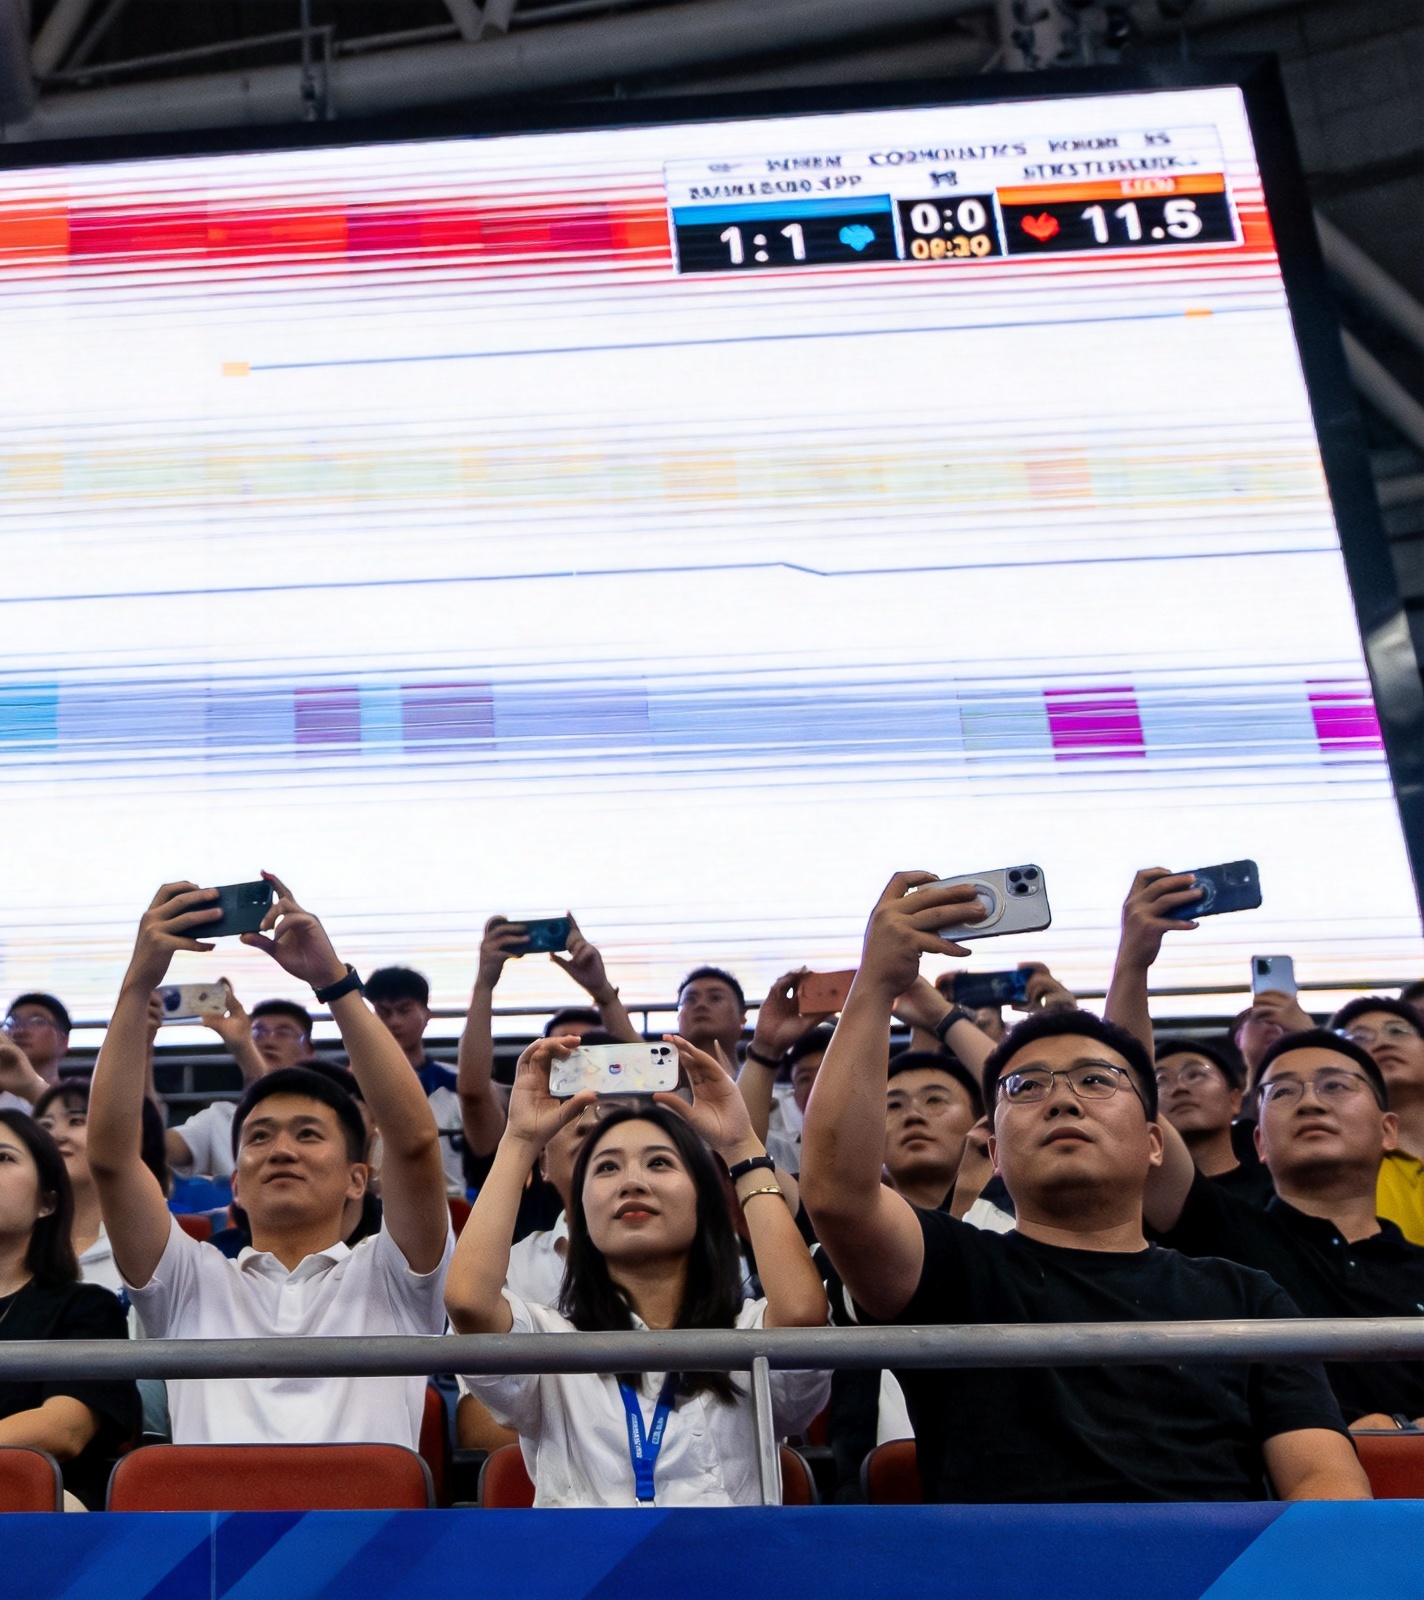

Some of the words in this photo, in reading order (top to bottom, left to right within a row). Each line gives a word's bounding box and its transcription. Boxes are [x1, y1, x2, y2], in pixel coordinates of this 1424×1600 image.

[910, 199, 987, 234] 0:0
[1080, 198, 1203, 244] 11.5
[720, 223, 806, 264] 1:1
